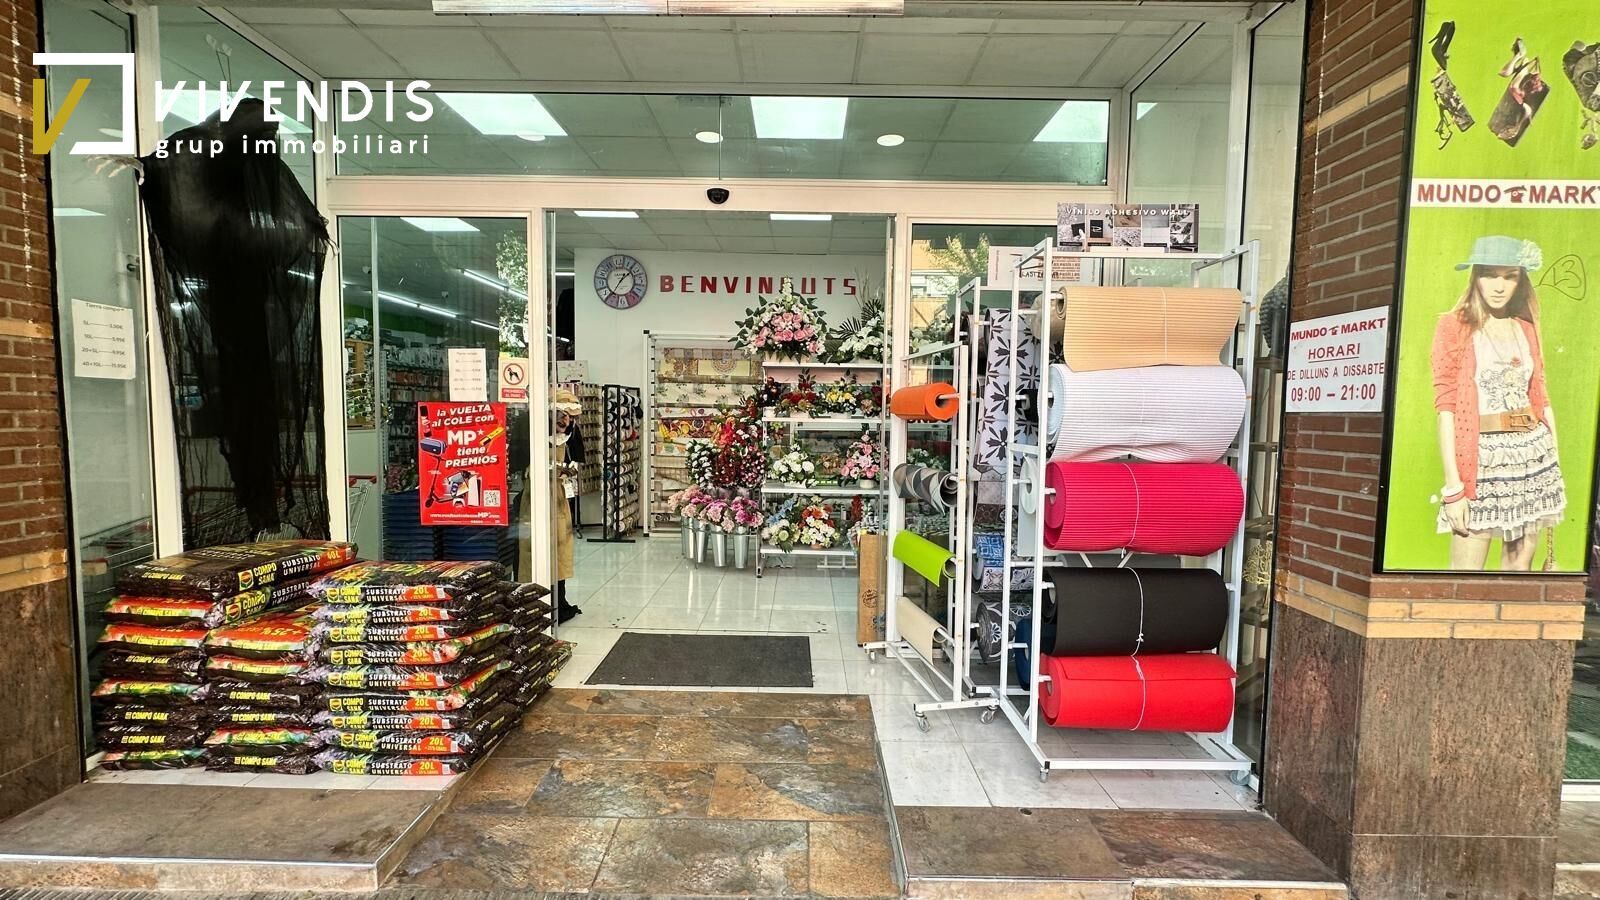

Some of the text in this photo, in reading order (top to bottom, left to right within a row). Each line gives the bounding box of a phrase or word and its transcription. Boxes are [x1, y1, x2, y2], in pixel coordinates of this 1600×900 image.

[1417, 184, 1600, 204] MUNDO MARK
[1066, 208, 1189, 216] VINILO ADHESIVO WALL
[1291, 318, 1386, 340] MUNDO MARKT
[1308, 342, 1361, 360] HORARI
[1287, 362, 1384, 380] DE DILLUNS A DISSABTE
[1291, 386, 1321, 402] 09:00
[1340, 383, 1376, 400] 21:00
[437, 404, 492, 417] la VUELTA
[432, 414, 494, 428] al COLE con
[457, 446, 486, 456] tiene
[445, 454, 498, 468] PREMIOS
[282, 554, 320, 568] SUBSTRATO
[253, 562, 278, 576] COMPO
[283, 563, 320, 576] UNIVERSAL
[272, 582, 310, 598] SUBSTRATO
[341, 588, 361, 596] COMPO
[242, 593, 266, 610] COMPO
[342, 627, 364, 635] COMPO
[415, 626, 430, 634] 20L
[344, 650, 364, 658] COMPO
[415, 698, 429, 706] 20L
[346, 716, 368, 724] COMPO
[420, 718, 435, 726] 20L
[355, 733, 377, 741] COMPO
[429, 737, 444, 746] 20L
[346, 760, 367, 769] COMPO
[420, 761, 435, 769] 20L
